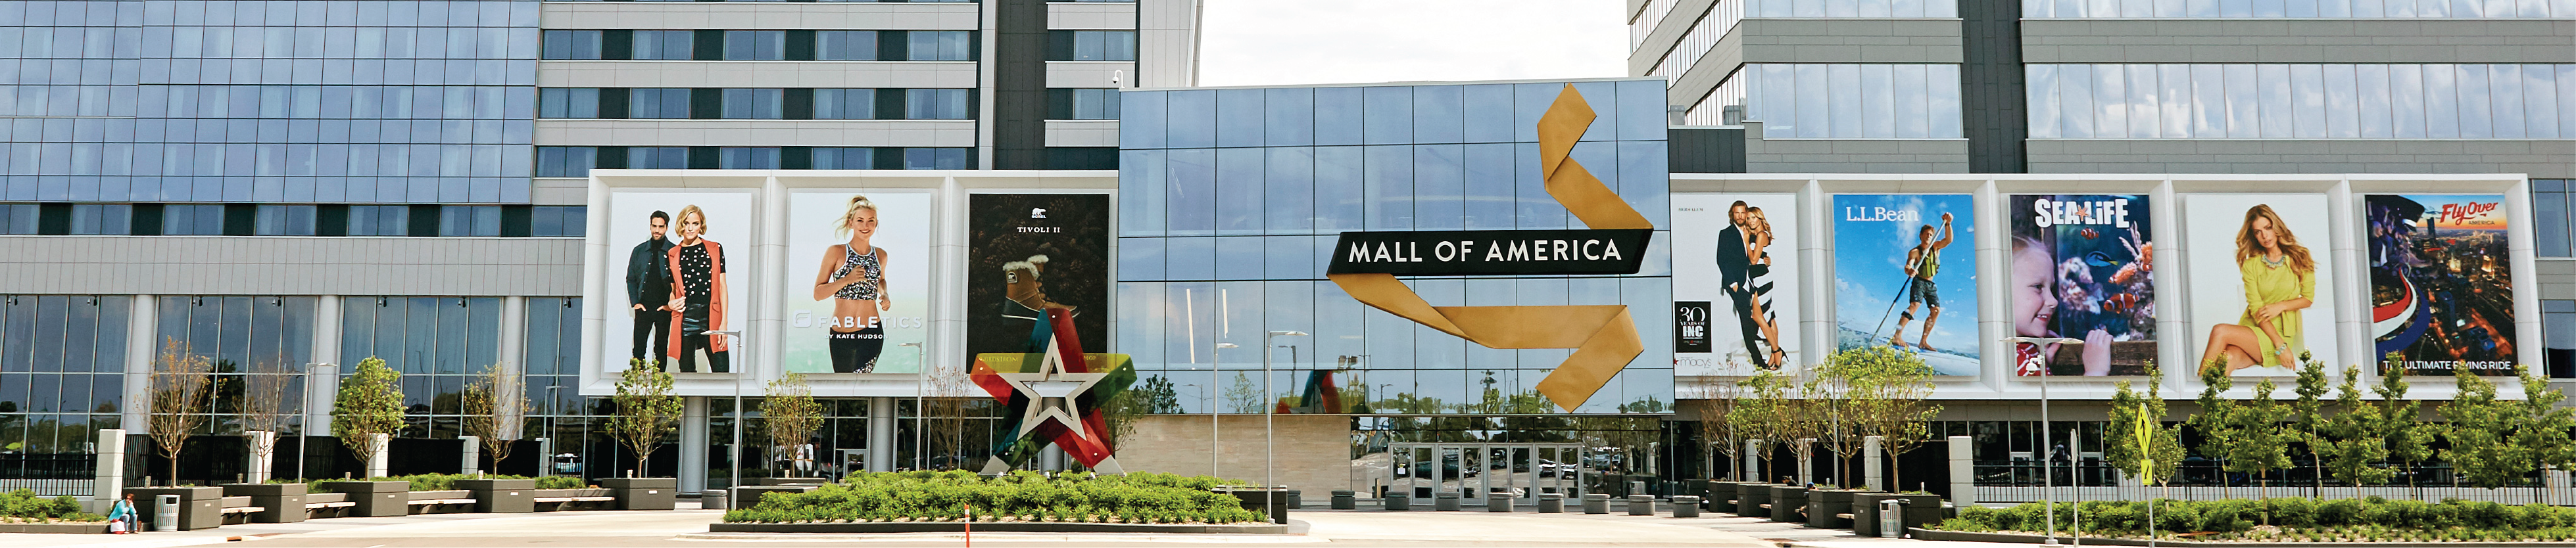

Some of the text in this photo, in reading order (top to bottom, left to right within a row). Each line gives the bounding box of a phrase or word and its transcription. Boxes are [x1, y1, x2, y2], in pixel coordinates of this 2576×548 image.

[1845, 206, 1919, 221] L.L.Bean
[2034, 198, 2081, 228] SEA
[1348, 239, 1622, 263] MALL OF AMERICA
[1680, 306, 1706, 322] 30
[817, 316, 921, 329] FABLETICS
[1682, 325, 1704, 338] INC
[2383, 360, 2403, 369] TE
[2404, 360, 2452, 370] ULTIMATE
[2489, 361, 2512, 370] RIDE
